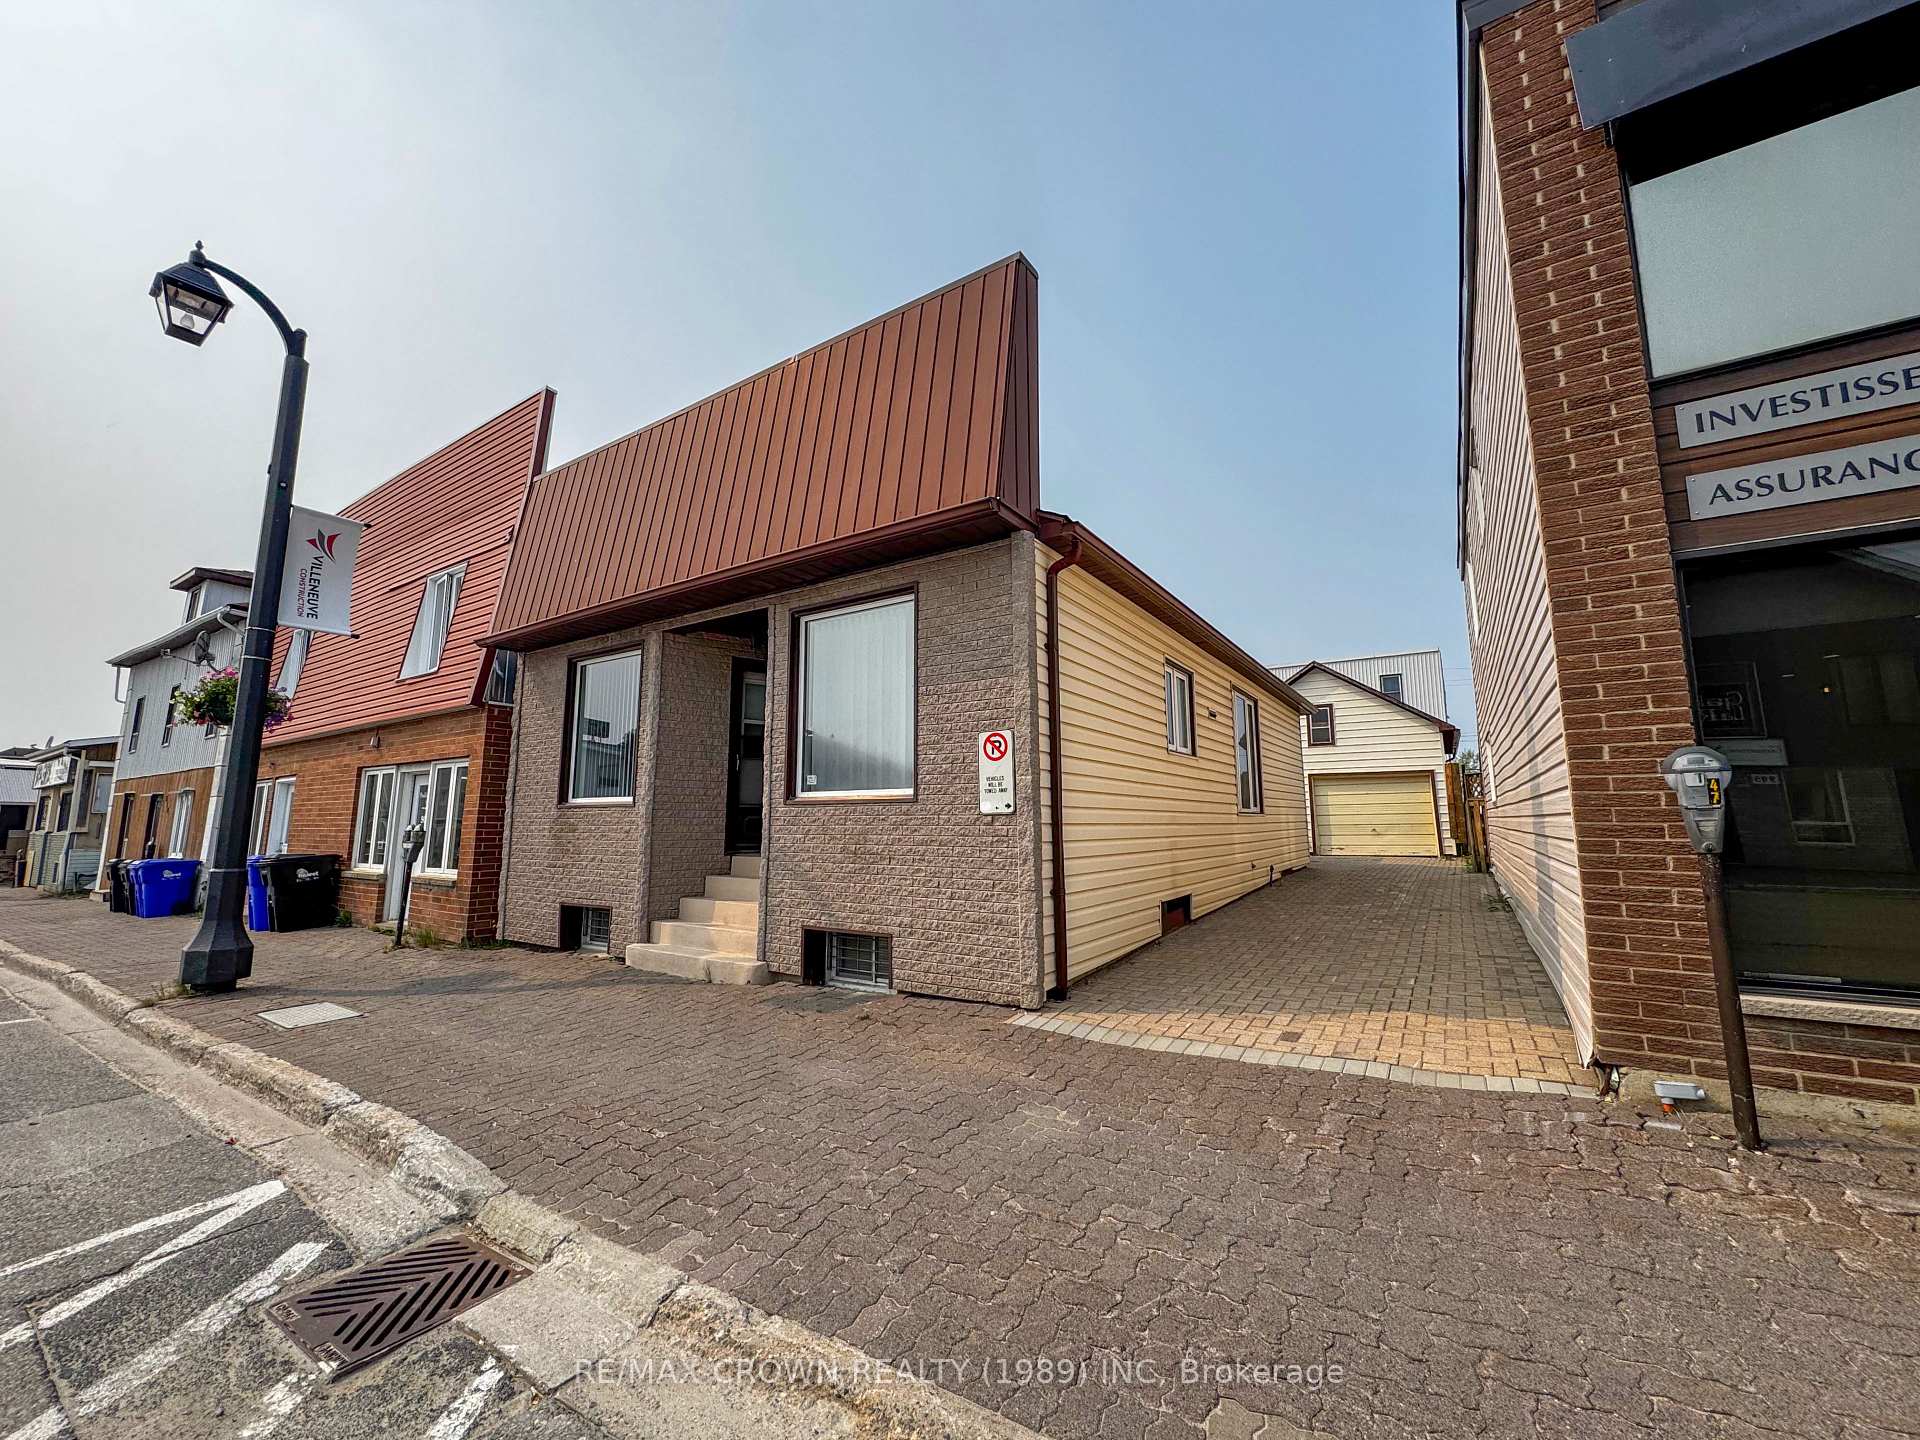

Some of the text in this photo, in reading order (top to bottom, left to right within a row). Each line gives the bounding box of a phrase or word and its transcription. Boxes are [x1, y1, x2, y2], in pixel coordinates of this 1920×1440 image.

[1695, 365, 1920, 433] INVESTISSE
[297, 568, 307, 617] CONSTRUCTION
[306, 556, 324, 619] VILLENEUVE
